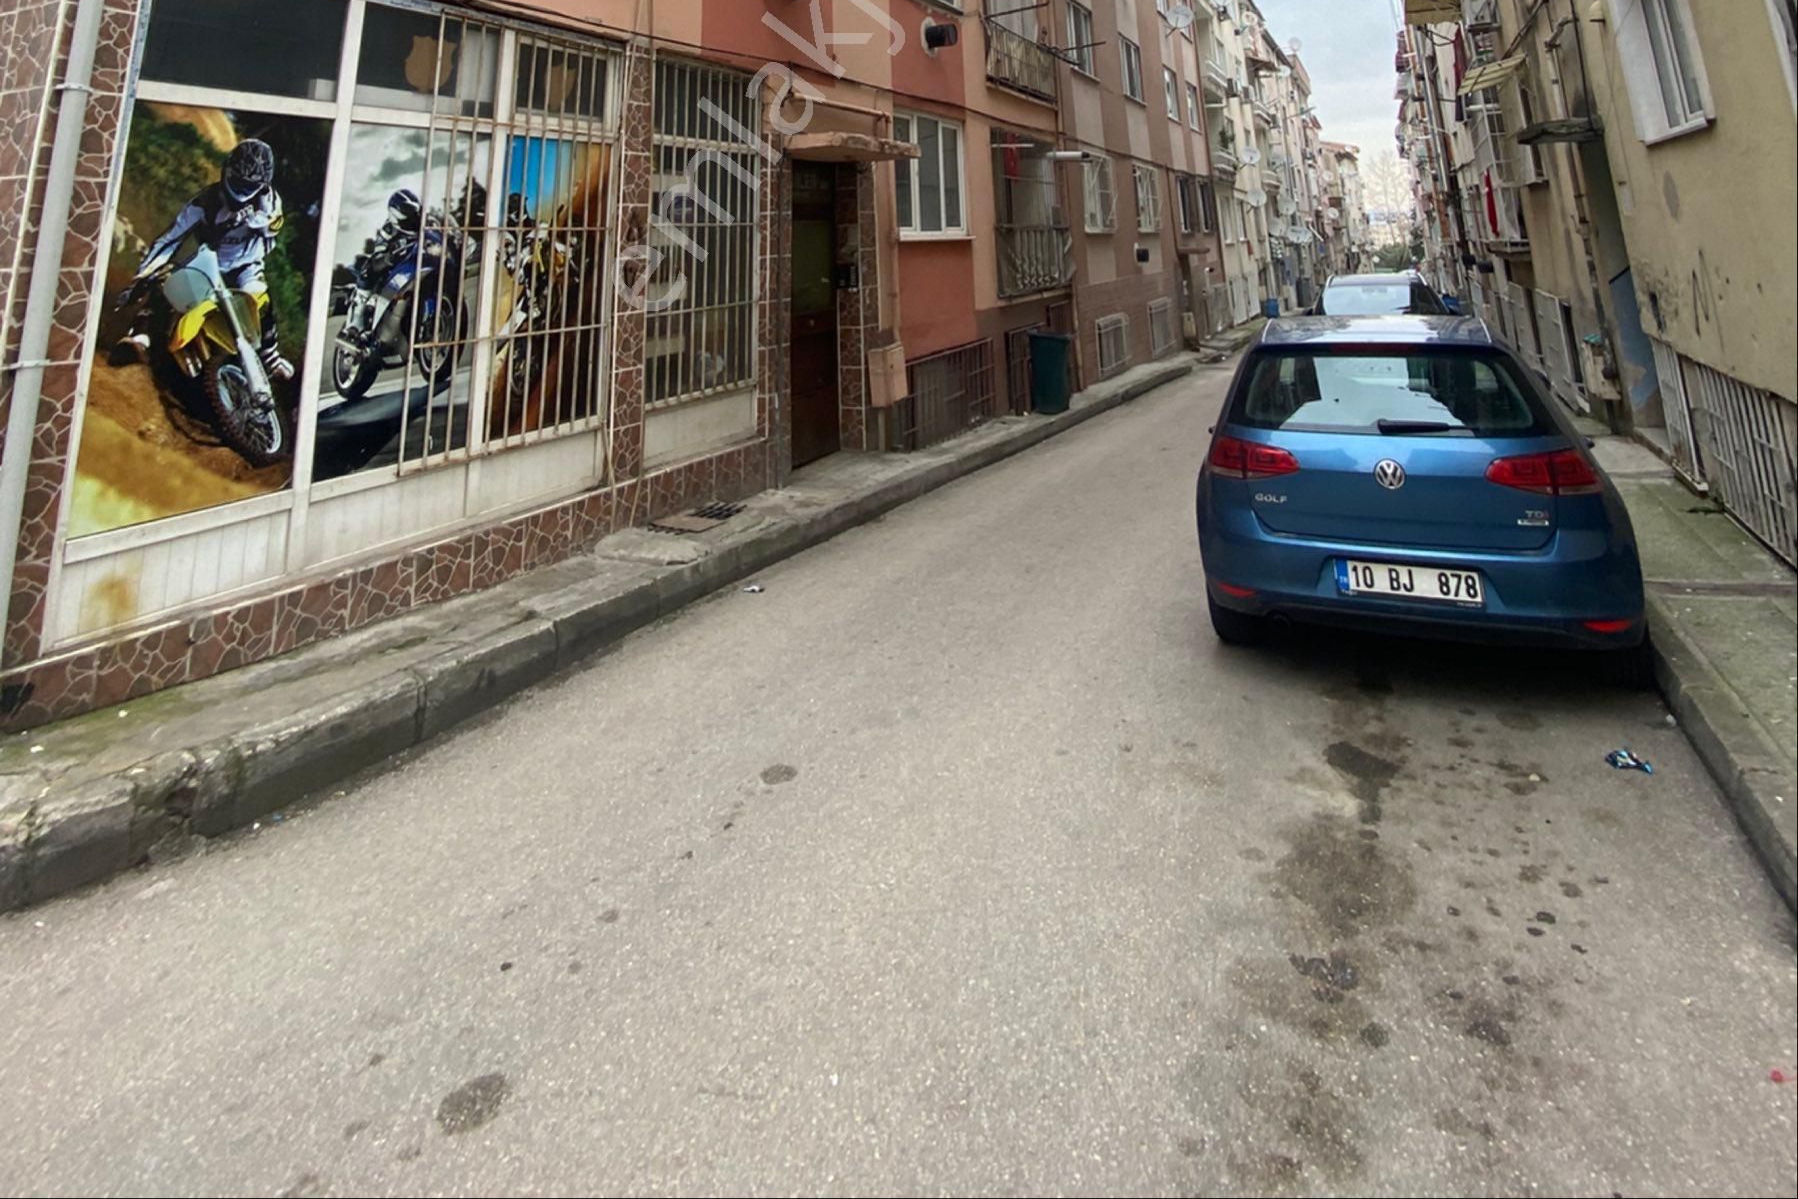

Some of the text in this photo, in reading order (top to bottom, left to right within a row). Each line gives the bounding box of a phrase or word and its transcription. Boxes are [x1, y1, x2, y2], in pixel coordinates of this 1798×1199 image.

[1255, 492, 1288, 503] GOLF
[1351, 564, 1478, 599] 10 BJ 878
